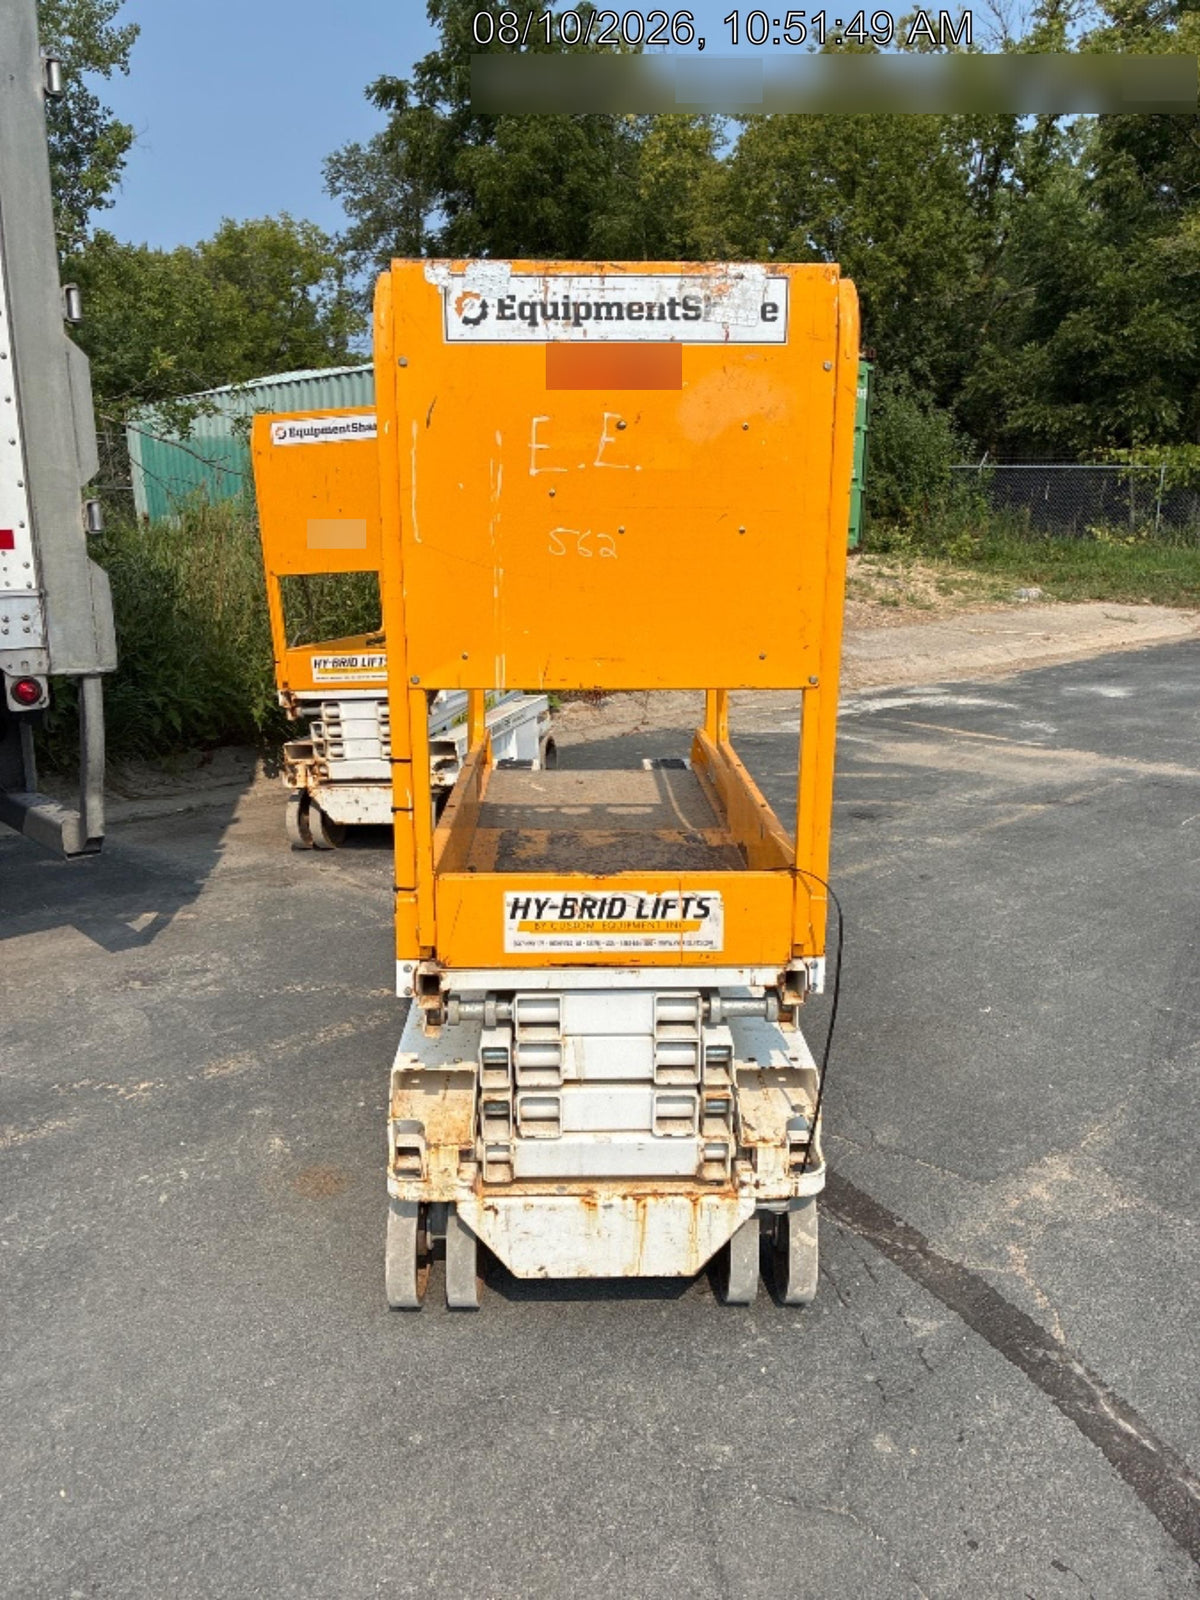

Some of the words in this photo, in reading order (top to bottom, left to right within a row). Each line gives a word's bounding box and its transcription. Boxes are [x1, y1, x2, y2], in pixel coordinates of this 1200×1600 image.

[496, 294, 779, 328] EquipmentSe
[548, 527, 618, 559] 562
[313, 657, 358, 669] HY-BRID
[509, 897, 627, 920] HY-BRID
[636, 897, 711, 920] LIFTS
